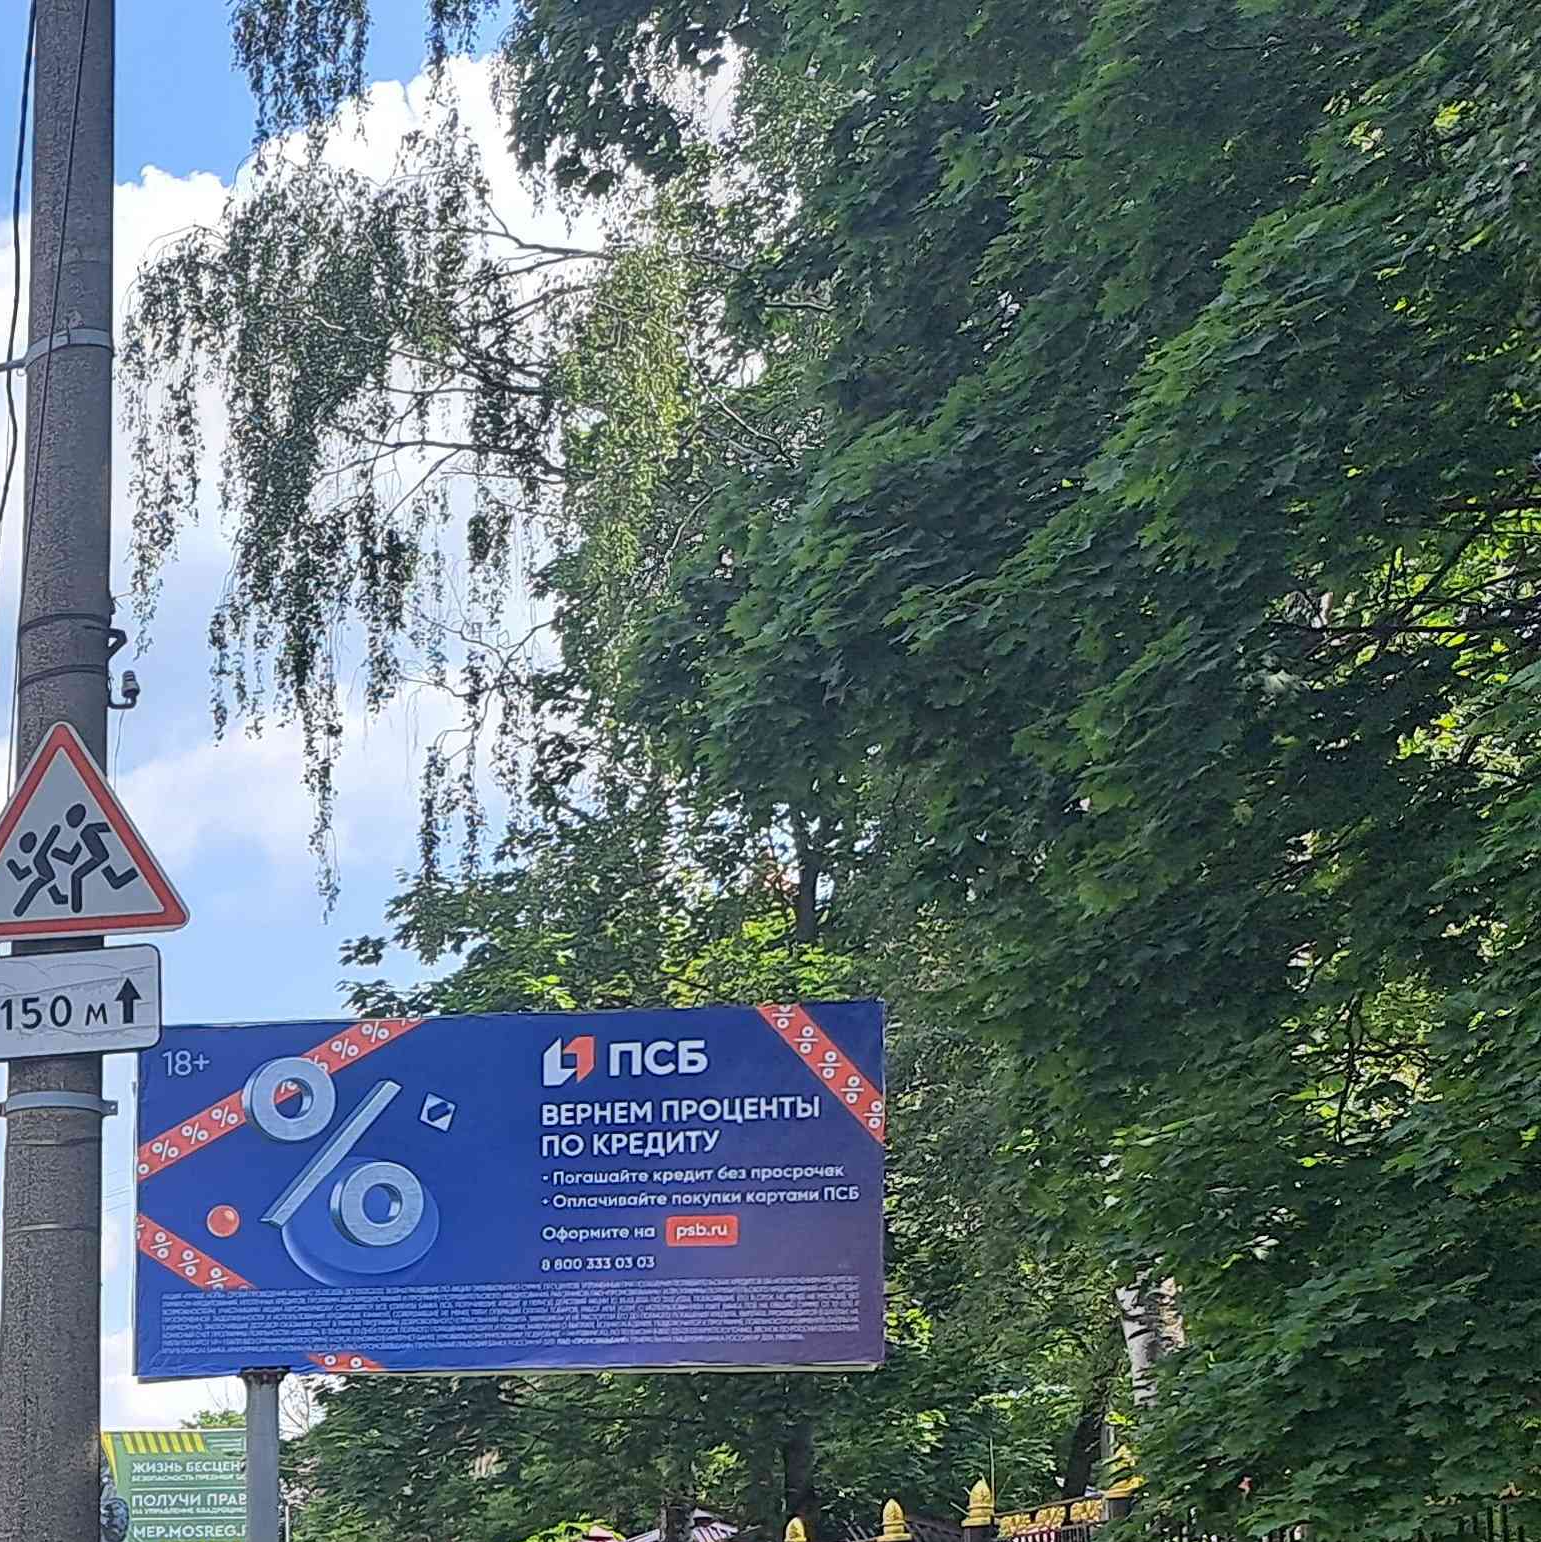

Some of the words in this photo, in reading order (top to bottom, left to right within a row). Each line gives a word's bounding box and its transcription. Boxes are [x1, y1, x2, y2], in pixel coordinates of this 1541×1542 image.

[0, 995, 72, 1030] 150
[162, 1050, 210, 1076] 18+
[609, 1040, 708, 1076] ПСБ
[541, 1101, 653, 1126] ВЕРНЕМ
[661, 1096, 819, 1123] ПРОЦЕНТЫ
[541, 1134, 584, 1157] ПО
[593, 1130, 720, 1157] КРЕДИТУ
[553, 1169, 649, 1185] Погашайте
[652, 1167, 713, 1184] кредит
[717, 1165, 747, 1180] без
[552, 1192, 667, 1208] Оплачивайте
[672, 1190, 742, 1208] покупки
[745, 1189, 819, 1206] картами
[823, 1185, 860, 1201] ПСБ
[542, 1226, 630, 1243] Оформите
[634, 1227, 656, 1239] на
[676, 1223, 729, 1241] psb.ru
[541, 1258, 550, 1271] 8
[554, 1258, 582, 1271] 800
[586, 1257, 611, 1270] 333
[615, 1256, 633, 1269] 03
[637, 1256, 655, 1269] 03
[132, 1461, 183, 1473] ЖИЗНЬ
[186, 1460, 245, 1473] БЕСЦЕН
[132, 1494, 202, 1506] ПОЛУЧИ
[207, 1493, 246, 1505] ПРАВ
[133, 1525, 245, 1538] MEP.MOSREG.
